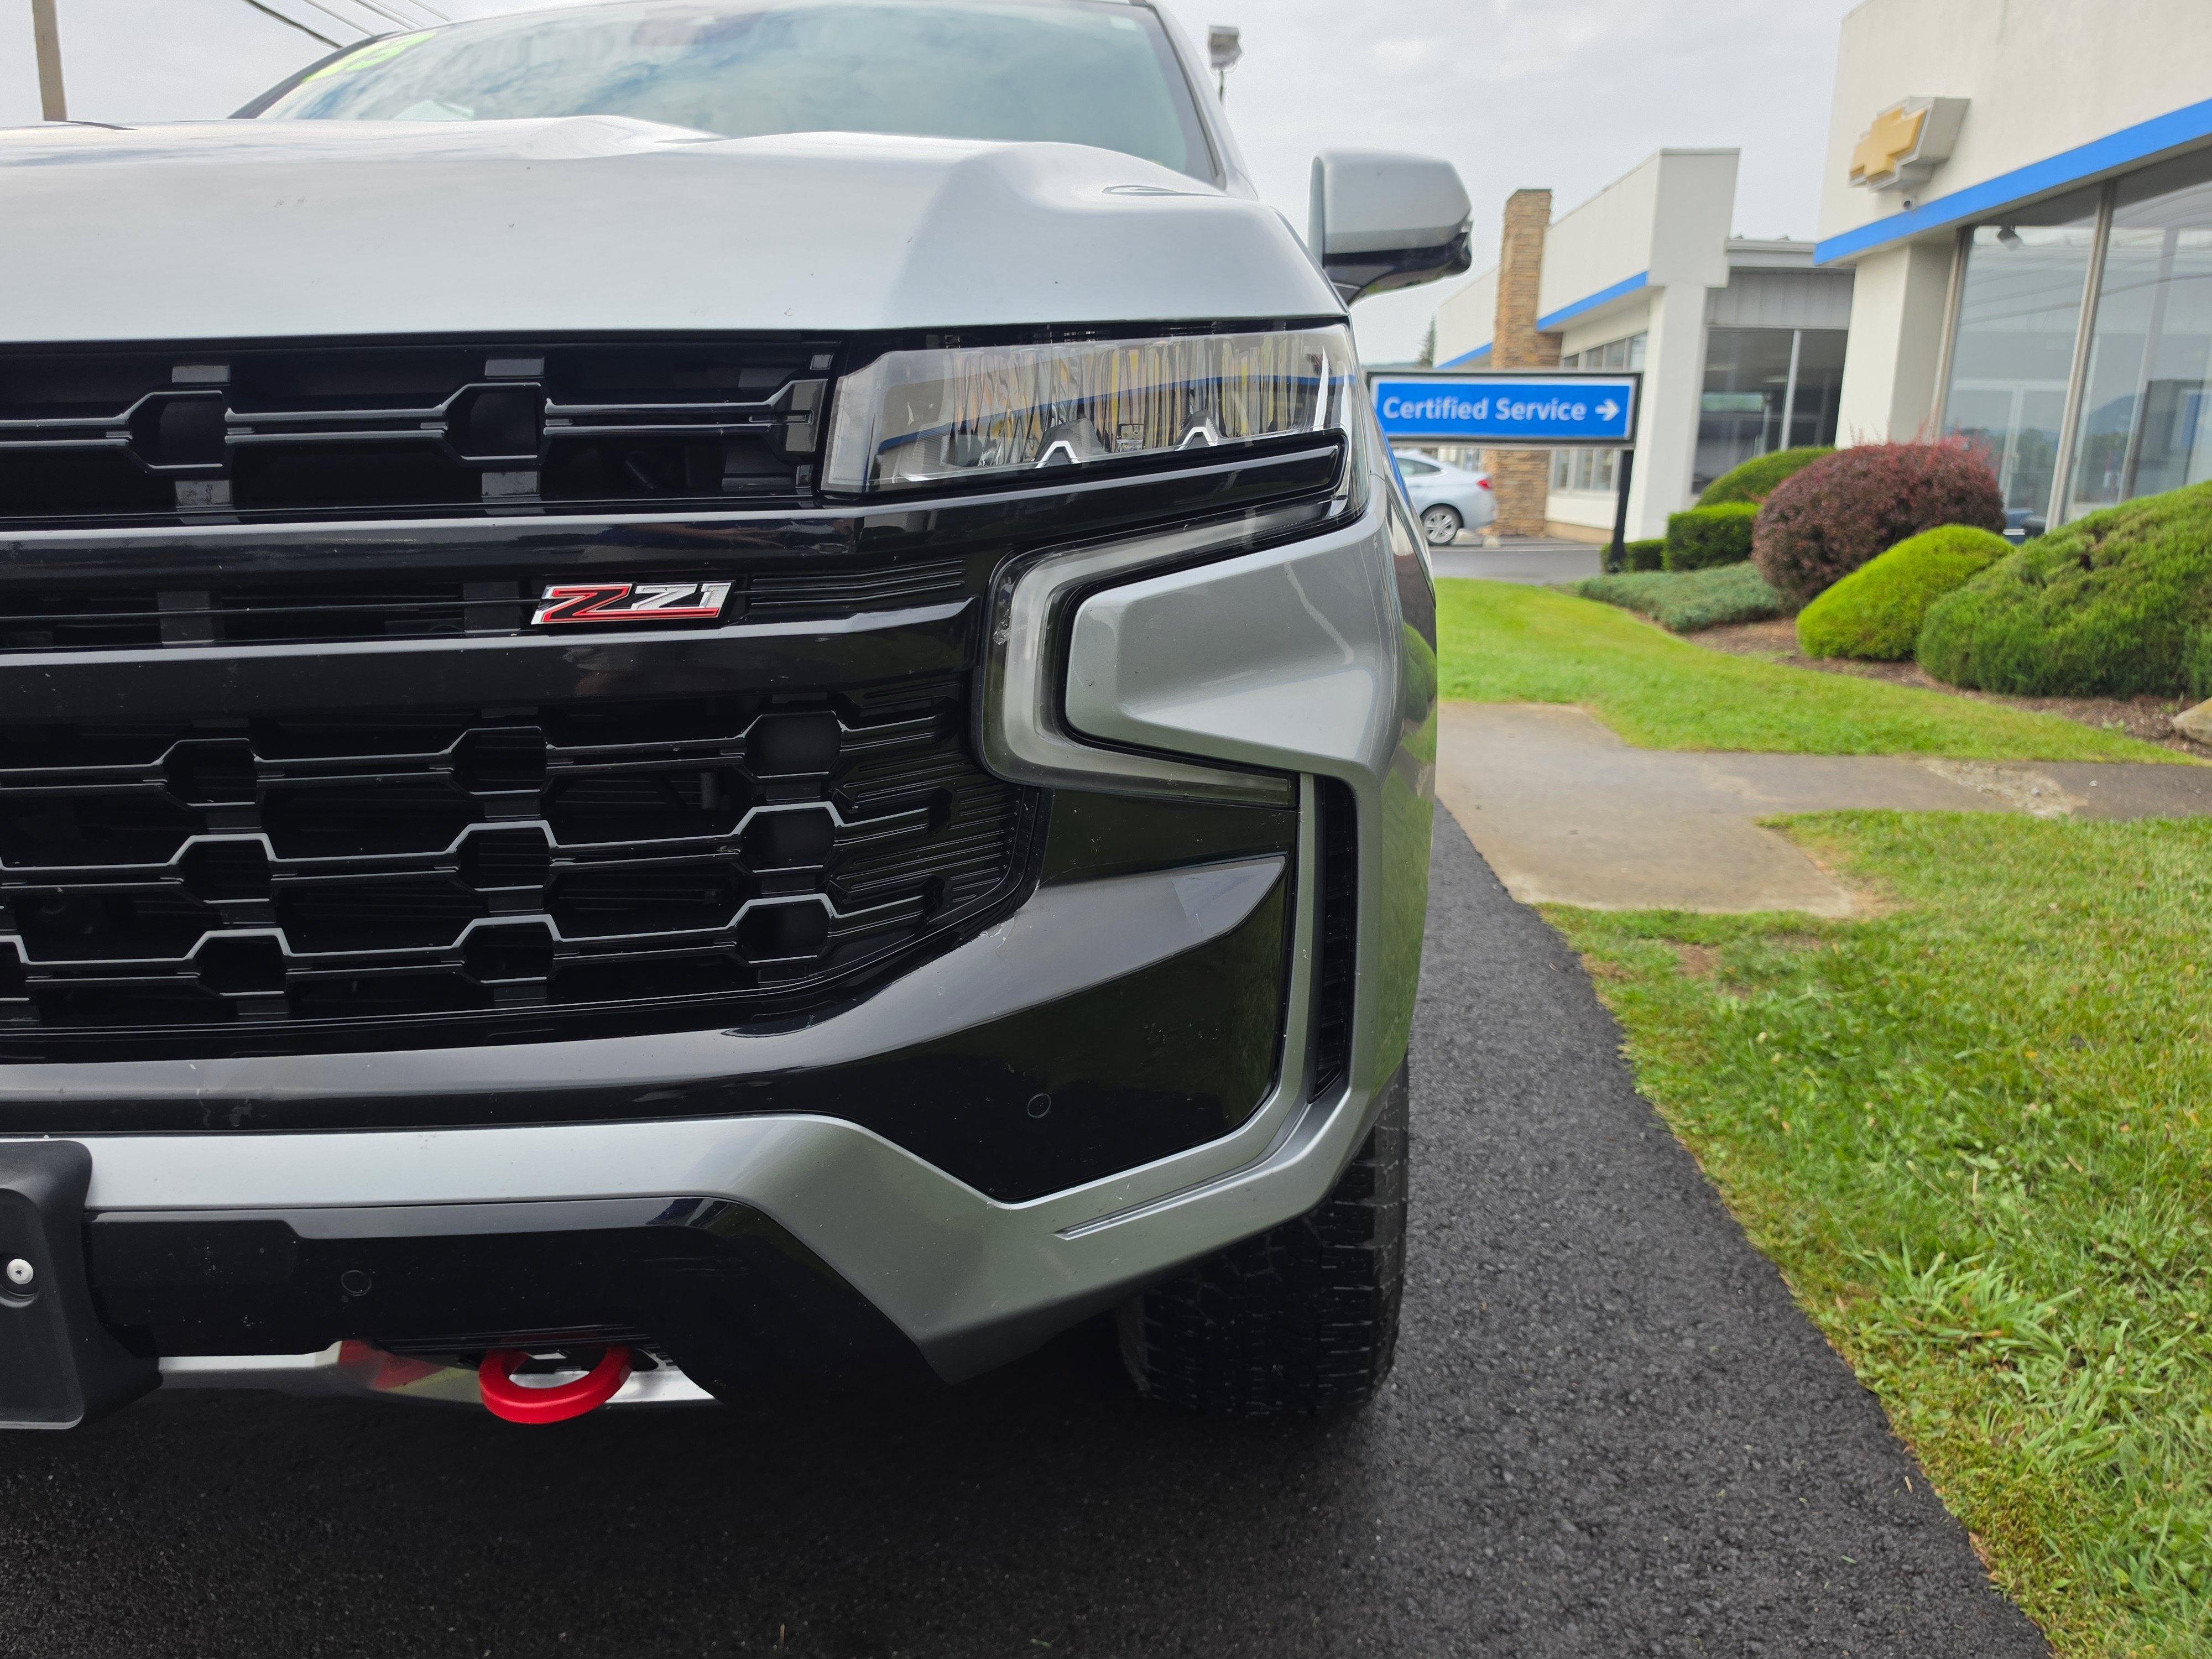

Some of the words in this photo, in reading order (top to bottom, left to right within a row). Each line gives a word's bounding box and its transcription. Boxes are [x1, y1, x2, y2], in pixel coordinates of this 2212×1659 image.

[1383, 395, 1488, 420] Certified
[1495, 397, 1586, 421] Service
[531, 583, 731, 624] Z71
